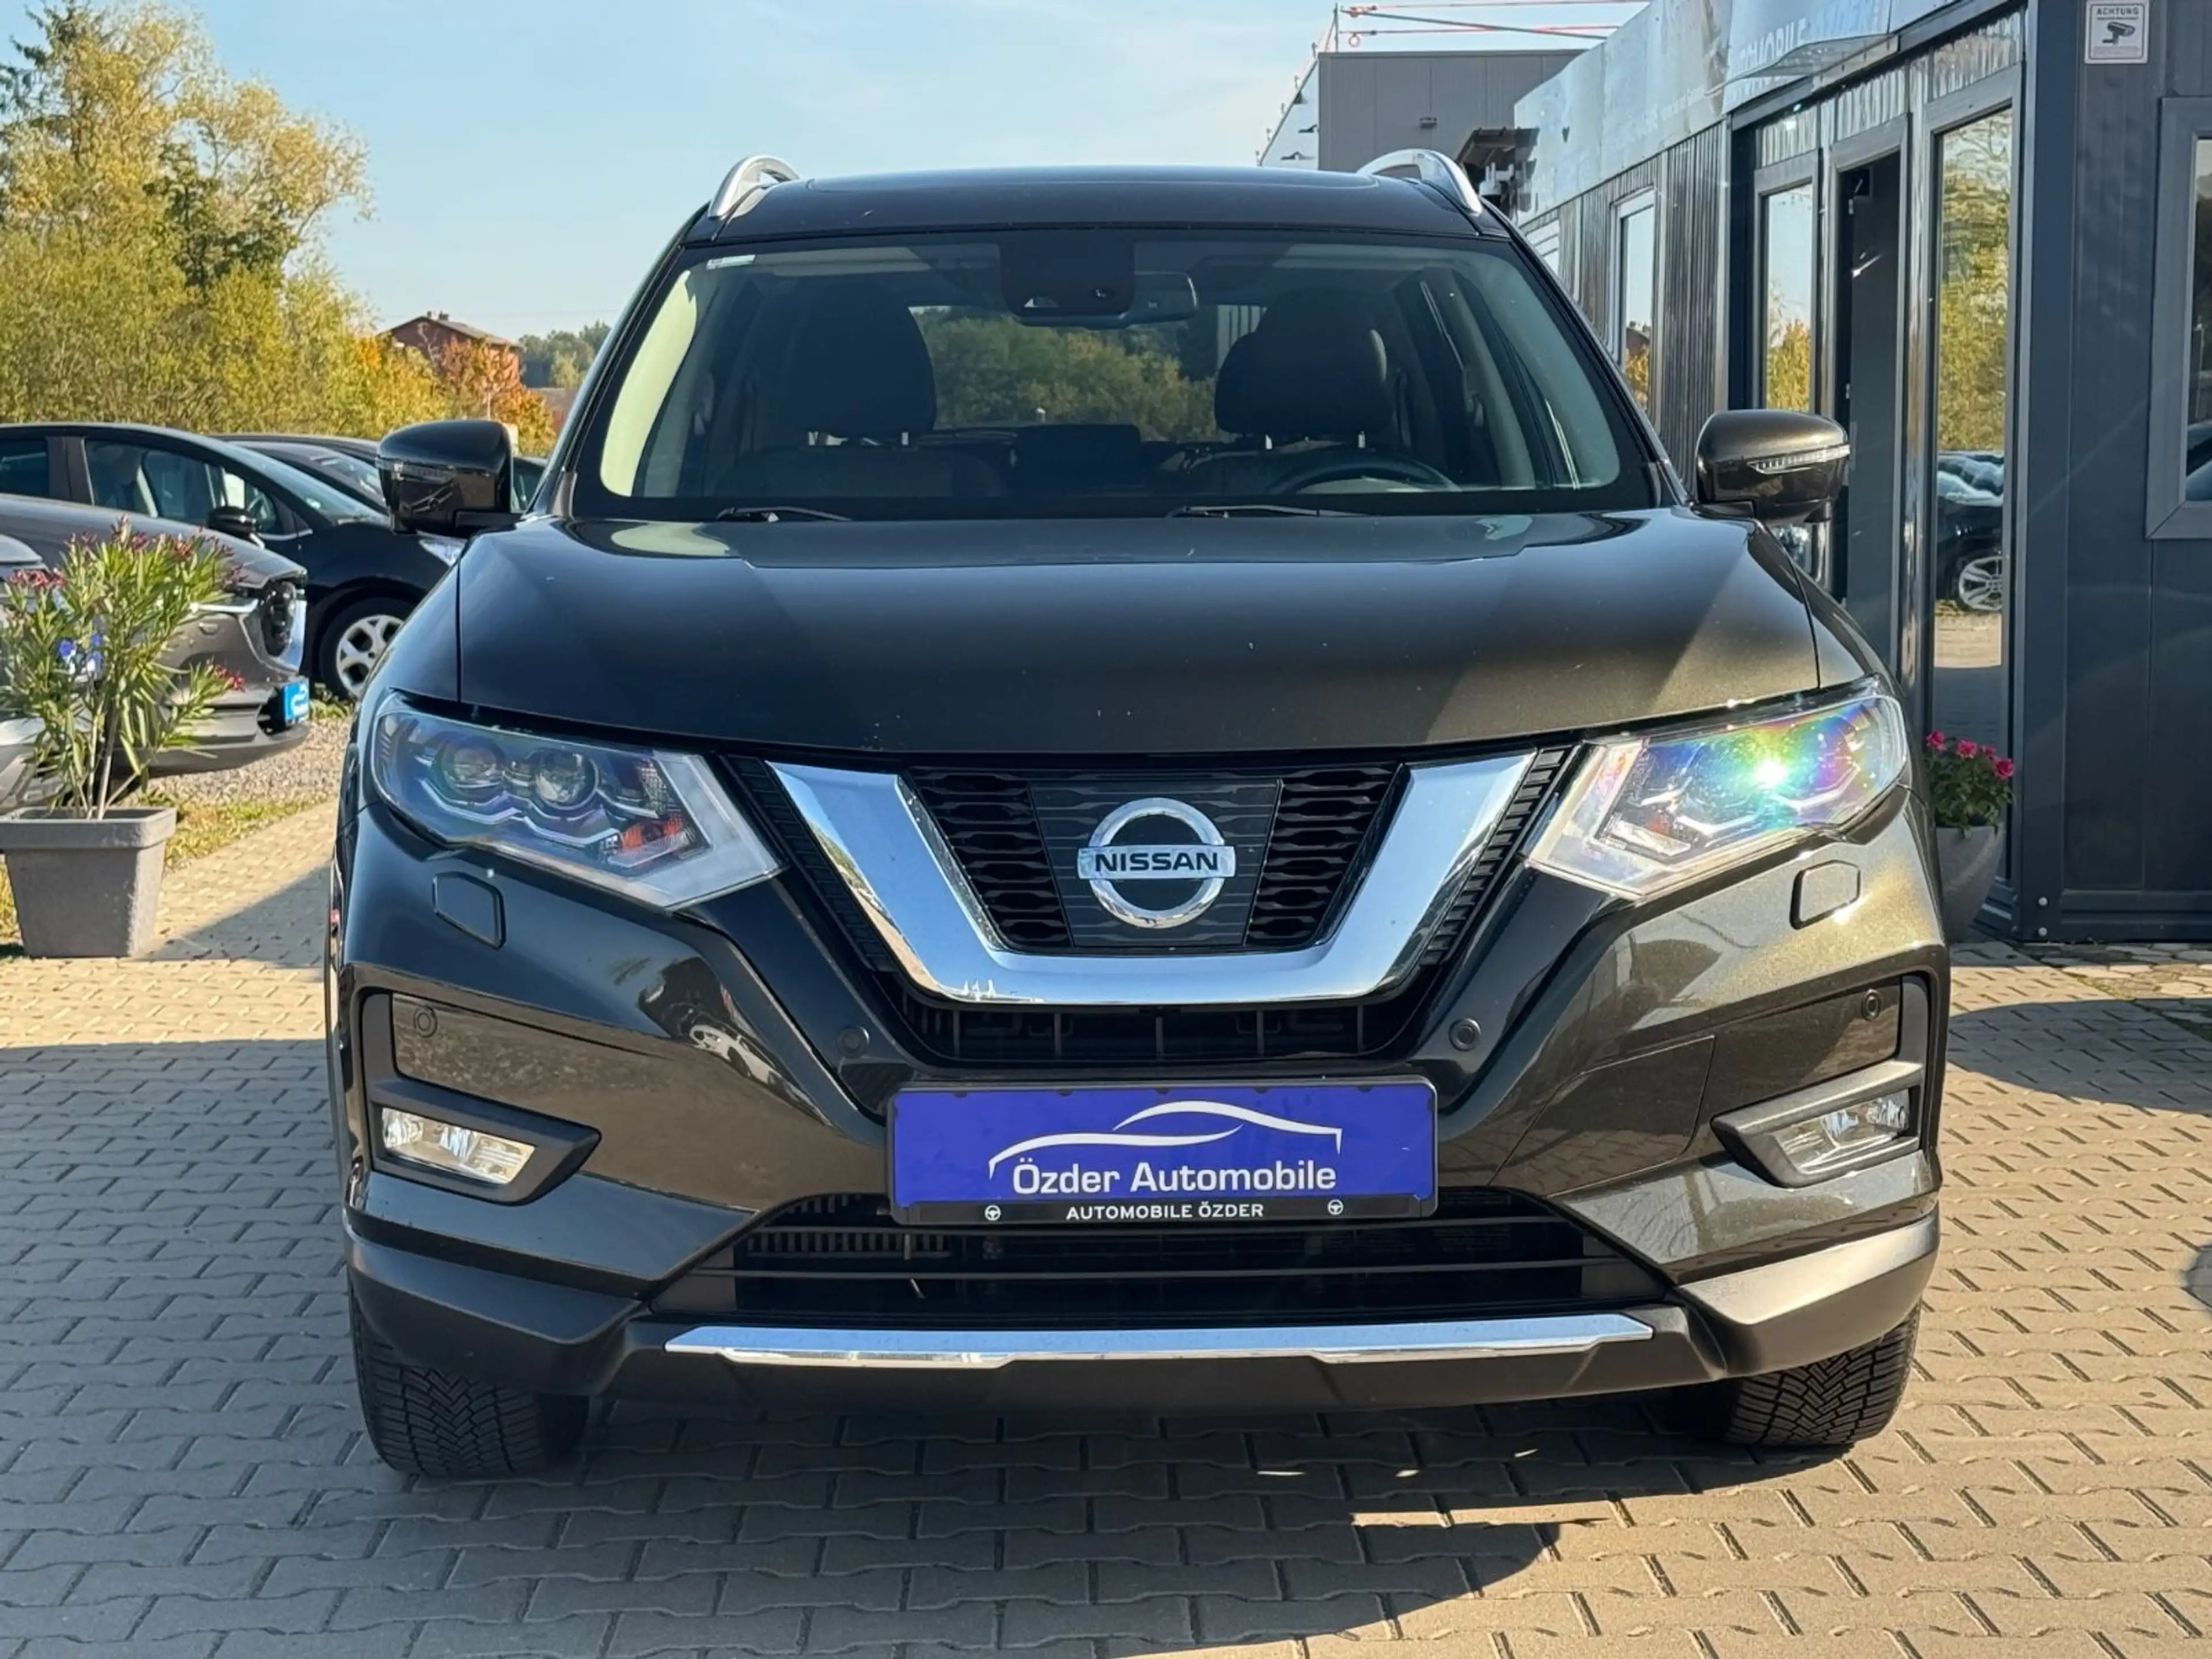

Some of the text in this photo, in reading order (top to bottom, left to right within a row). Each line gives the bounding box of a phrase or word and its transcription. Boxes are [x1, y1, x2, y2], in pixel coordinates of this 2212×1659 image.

[2096, 6, 2139, 16] ACHTUNG
[1095, 852, 1218, 872] NISSAN
[1013, 1157, 1337, 1195] Özder Automobile
[1066, 1200, 1264, 1221] AUTOMOBILE ÖZDER
